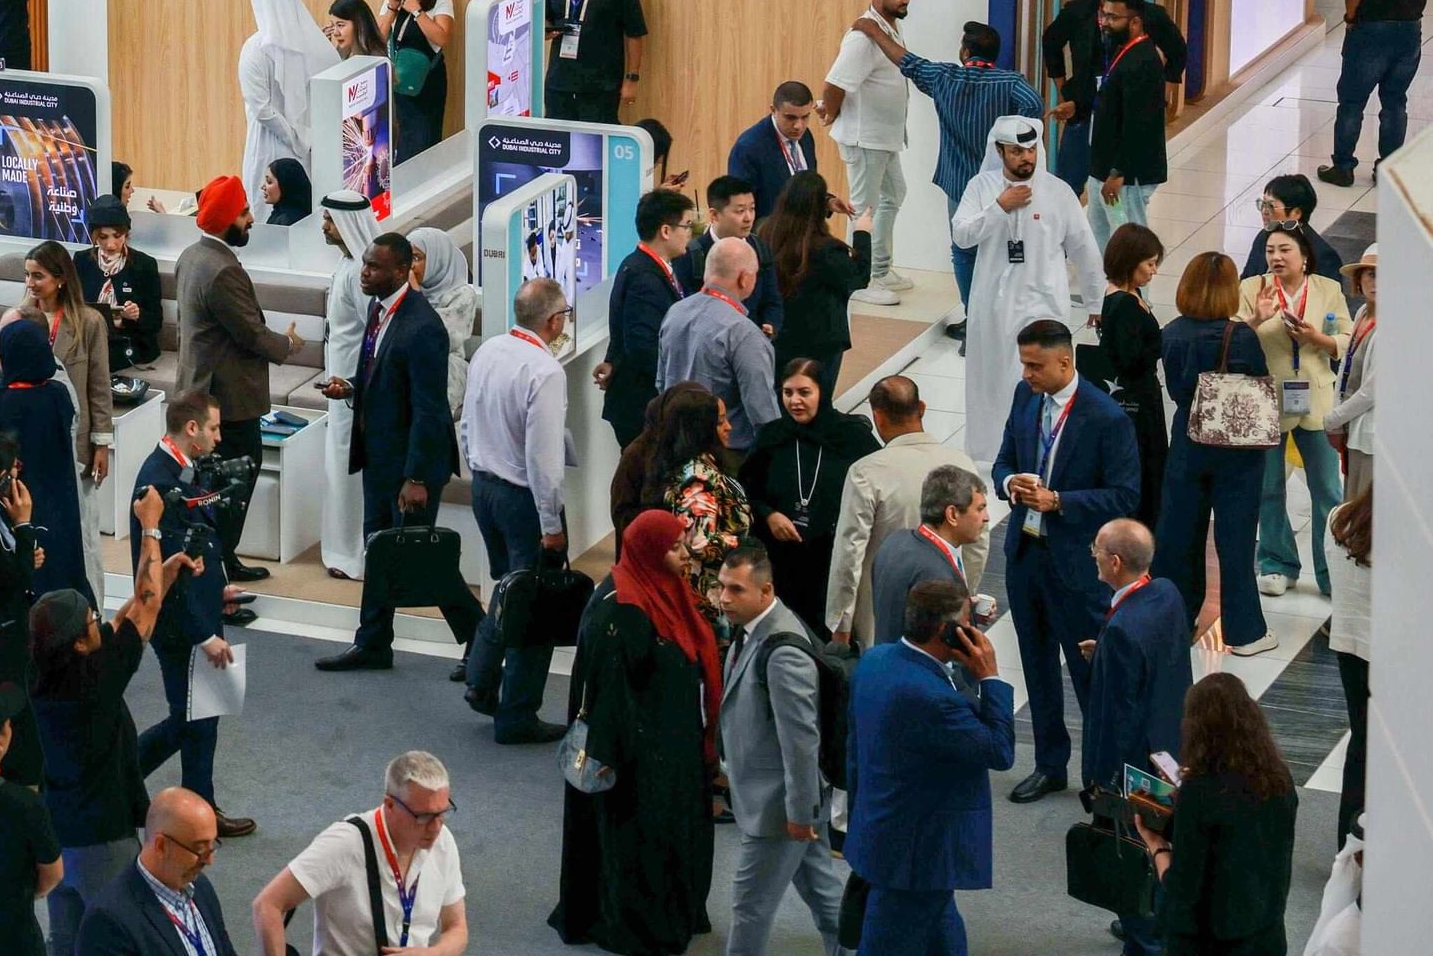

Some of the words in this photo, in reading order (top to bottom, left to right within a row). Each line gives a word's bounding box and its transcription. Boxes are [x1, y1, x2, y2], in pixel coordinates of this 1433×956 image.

[19, 99, 46, 107] INDUSTRIAL
[519, 146, 548, 154] INDUSTRIAL
[614, 145, 634, 160] 05
[2, 155, 38, 171] LOCALLY
[2, 169, 28, 183] MADE
[47, 185, 77, 198] صناعة
[48, 199, 78, 215] وطنية
[483, 249, 505, 258] DUBAI
[198, 493, 221, 506] RONIN
